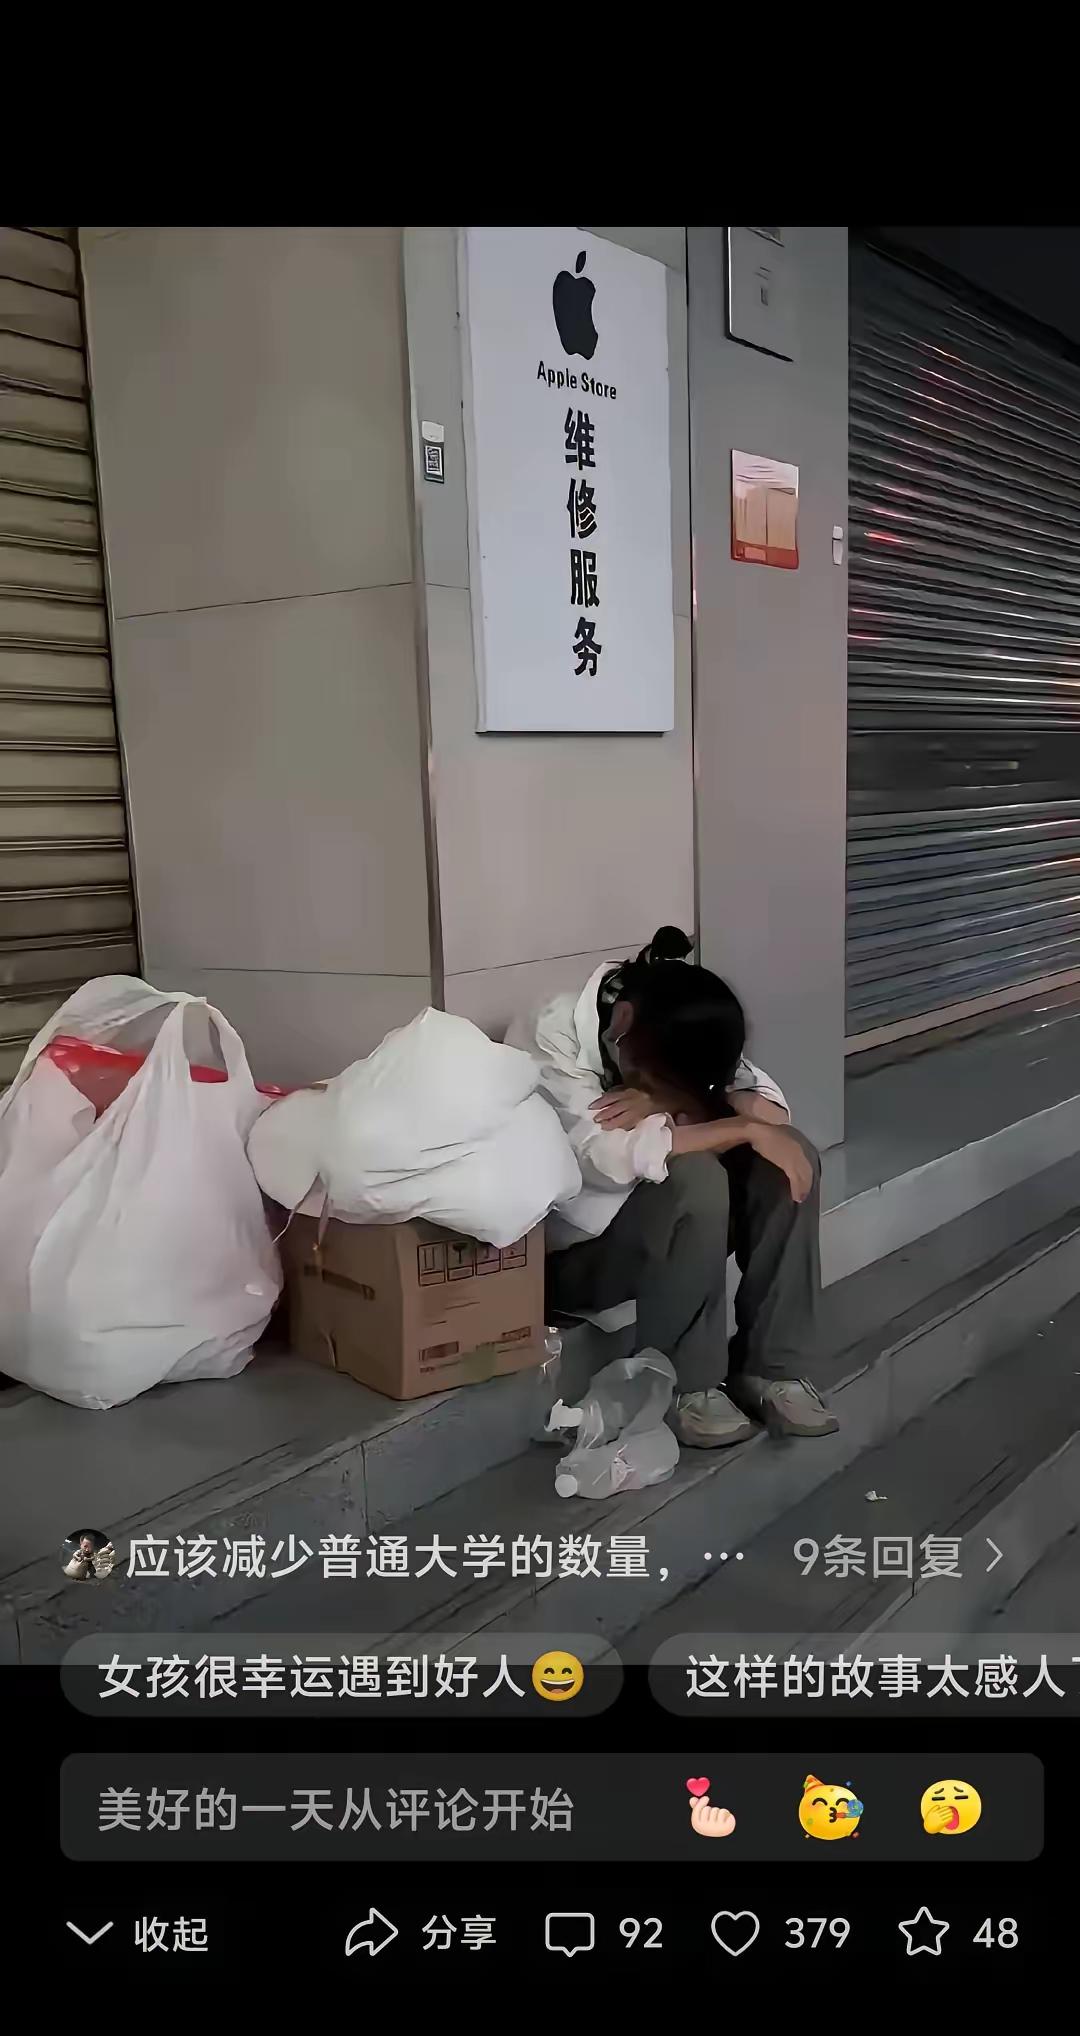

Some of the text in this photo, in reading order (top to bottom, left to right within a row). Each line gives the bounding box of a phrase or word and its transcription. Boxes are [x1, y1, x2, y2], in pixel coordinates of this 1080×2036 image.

[536, 360, 617, 400] Apple Store
[564, 406, 603, 677] 维修服务
